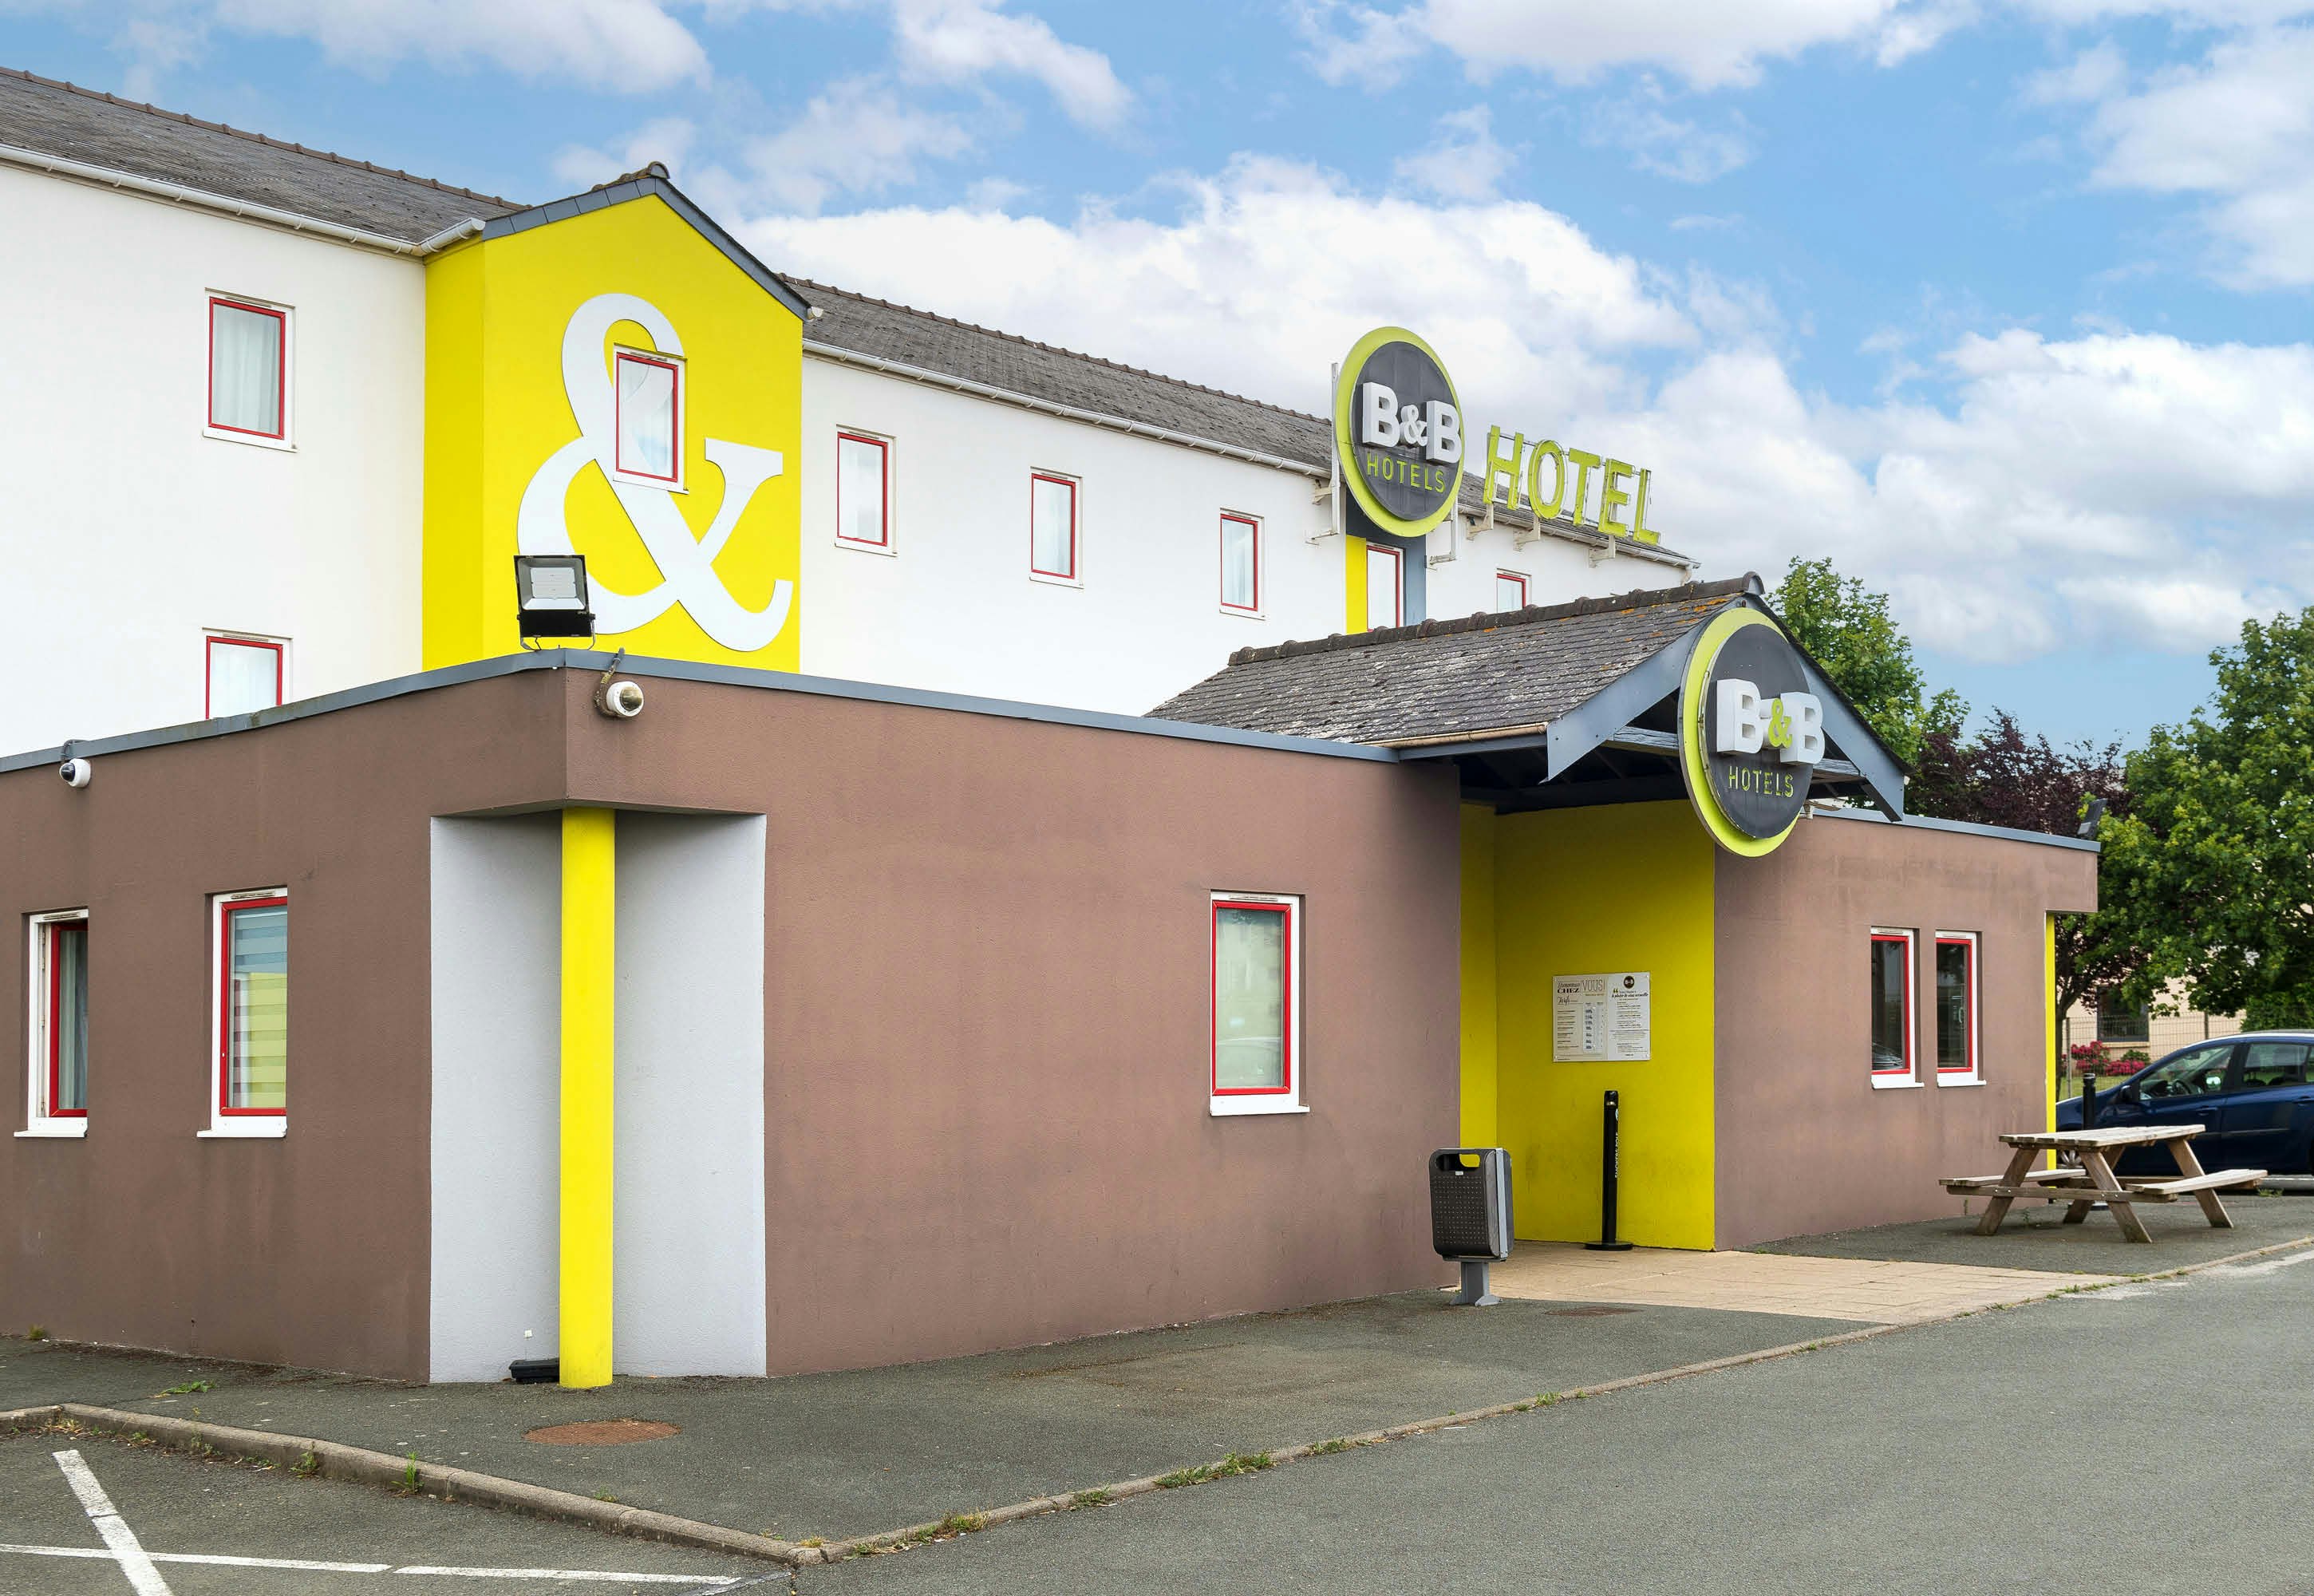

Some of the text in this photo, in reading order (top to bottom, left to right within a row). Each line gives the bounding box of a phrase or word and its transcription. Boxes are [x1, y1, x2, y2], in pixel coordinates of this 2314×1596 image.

[1361, 381, 1463, 464] B&B
[1366, 452, 1447, 495] HOTELS
[1483, 424, 1661, 546] HOTEL
[1716, 678, 1826, 765] B&B
[1728, 765, 1795, 799] HOTELS
